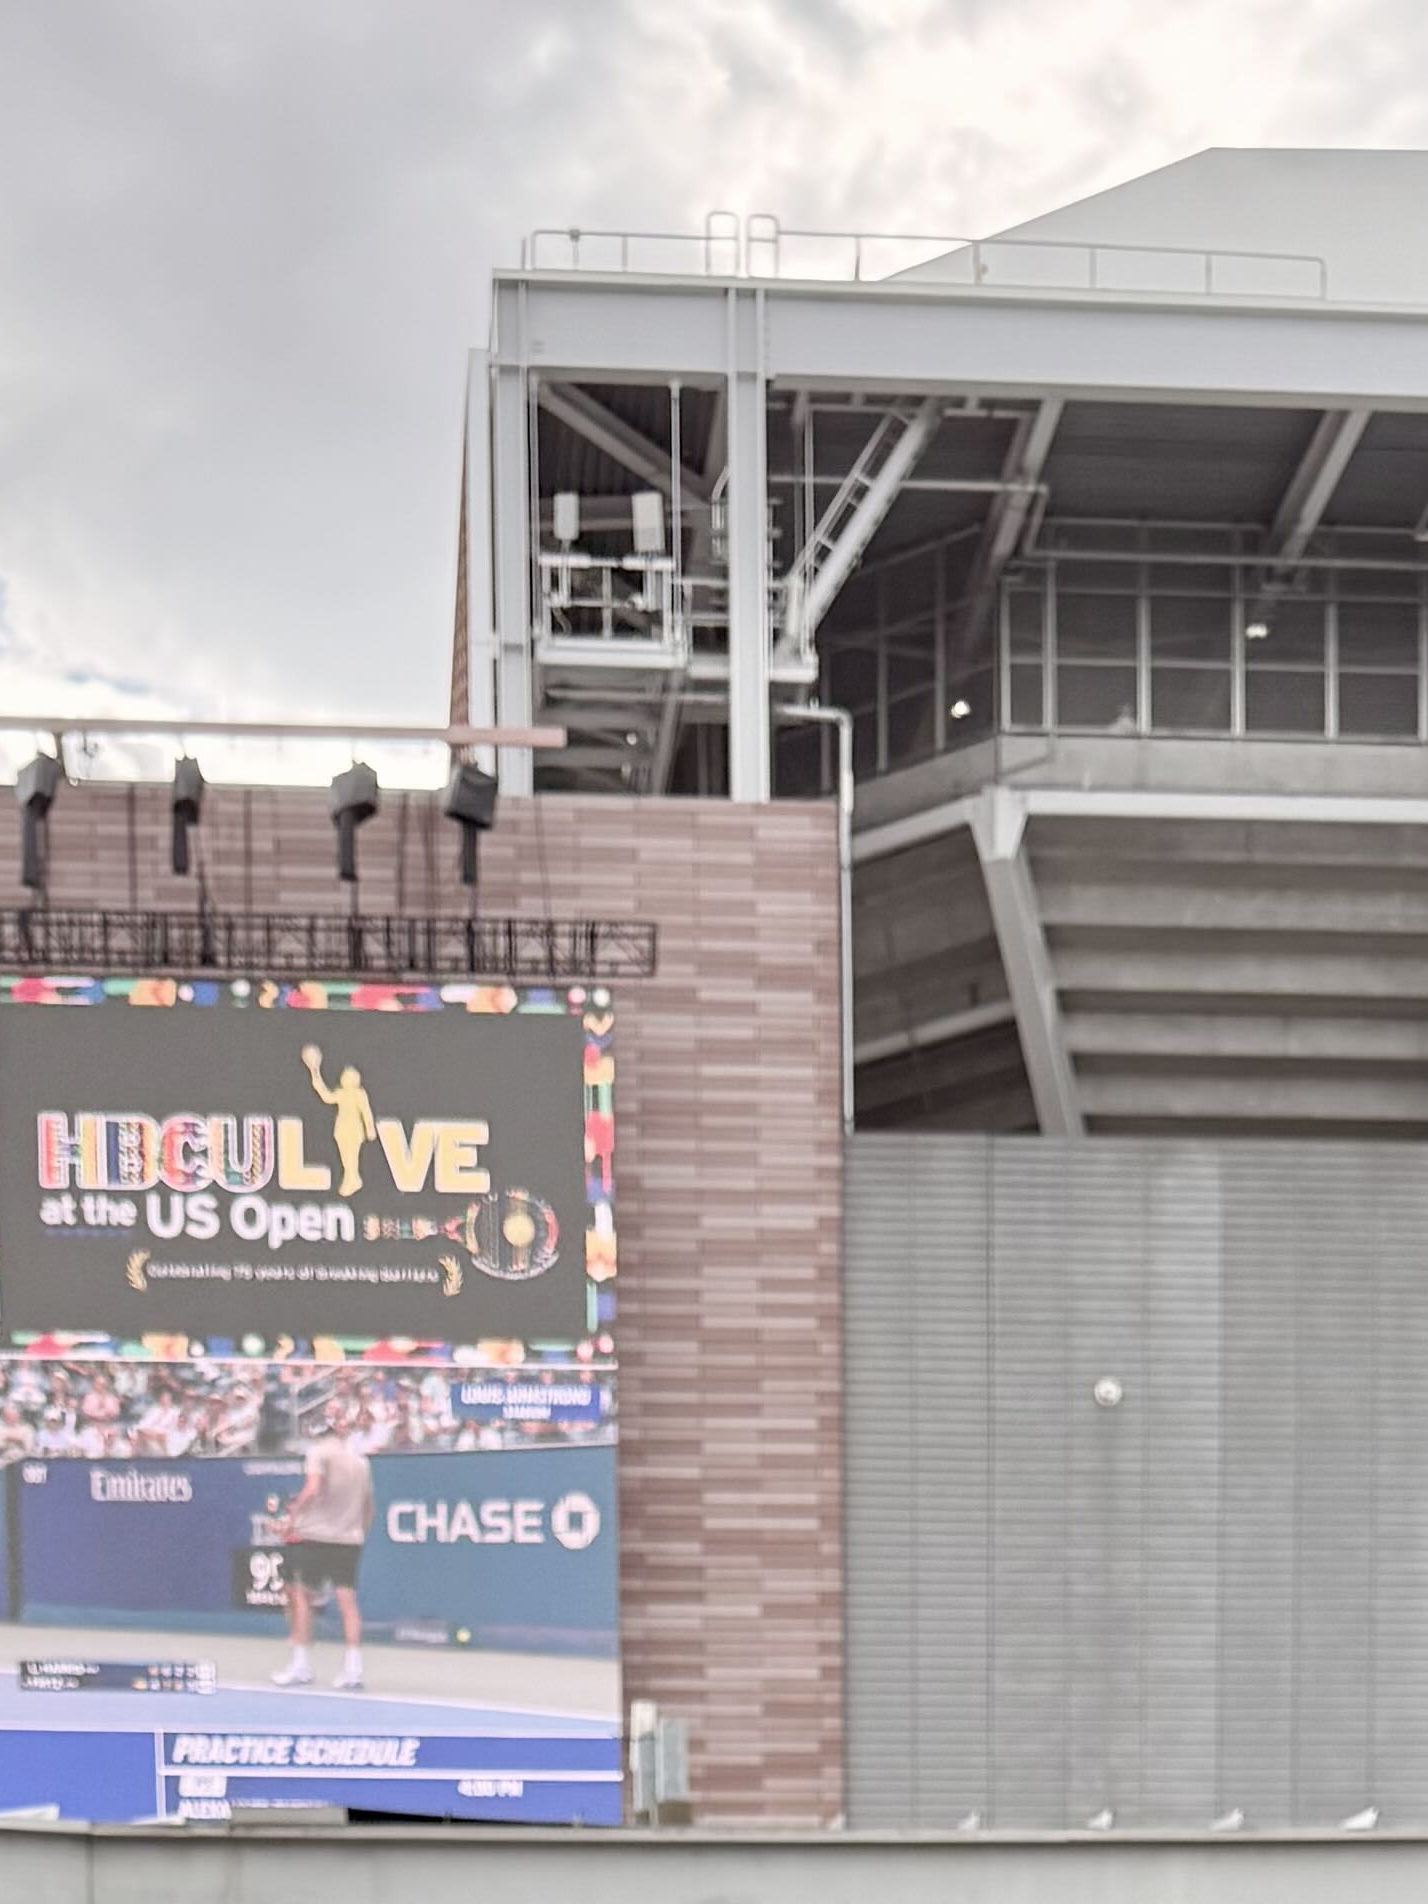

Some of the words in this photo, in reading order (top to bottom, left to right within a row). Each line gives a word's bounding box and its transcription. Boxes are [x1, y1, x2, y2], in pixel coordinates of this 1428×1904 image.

[40, 1192, 77, 1225] at
[81, 1194, 138, 1227] the
[145, 1193, 222, 1240] US
[230, 1193, 356, 1250] Open
[90, 1470, 192, 1502] Emirates
[387, 1500, 545, 1544] CHASE
[172, 1732, 294, 1764] PRACTICE
[292, 1734, 421, 1766] SCHEDULE
